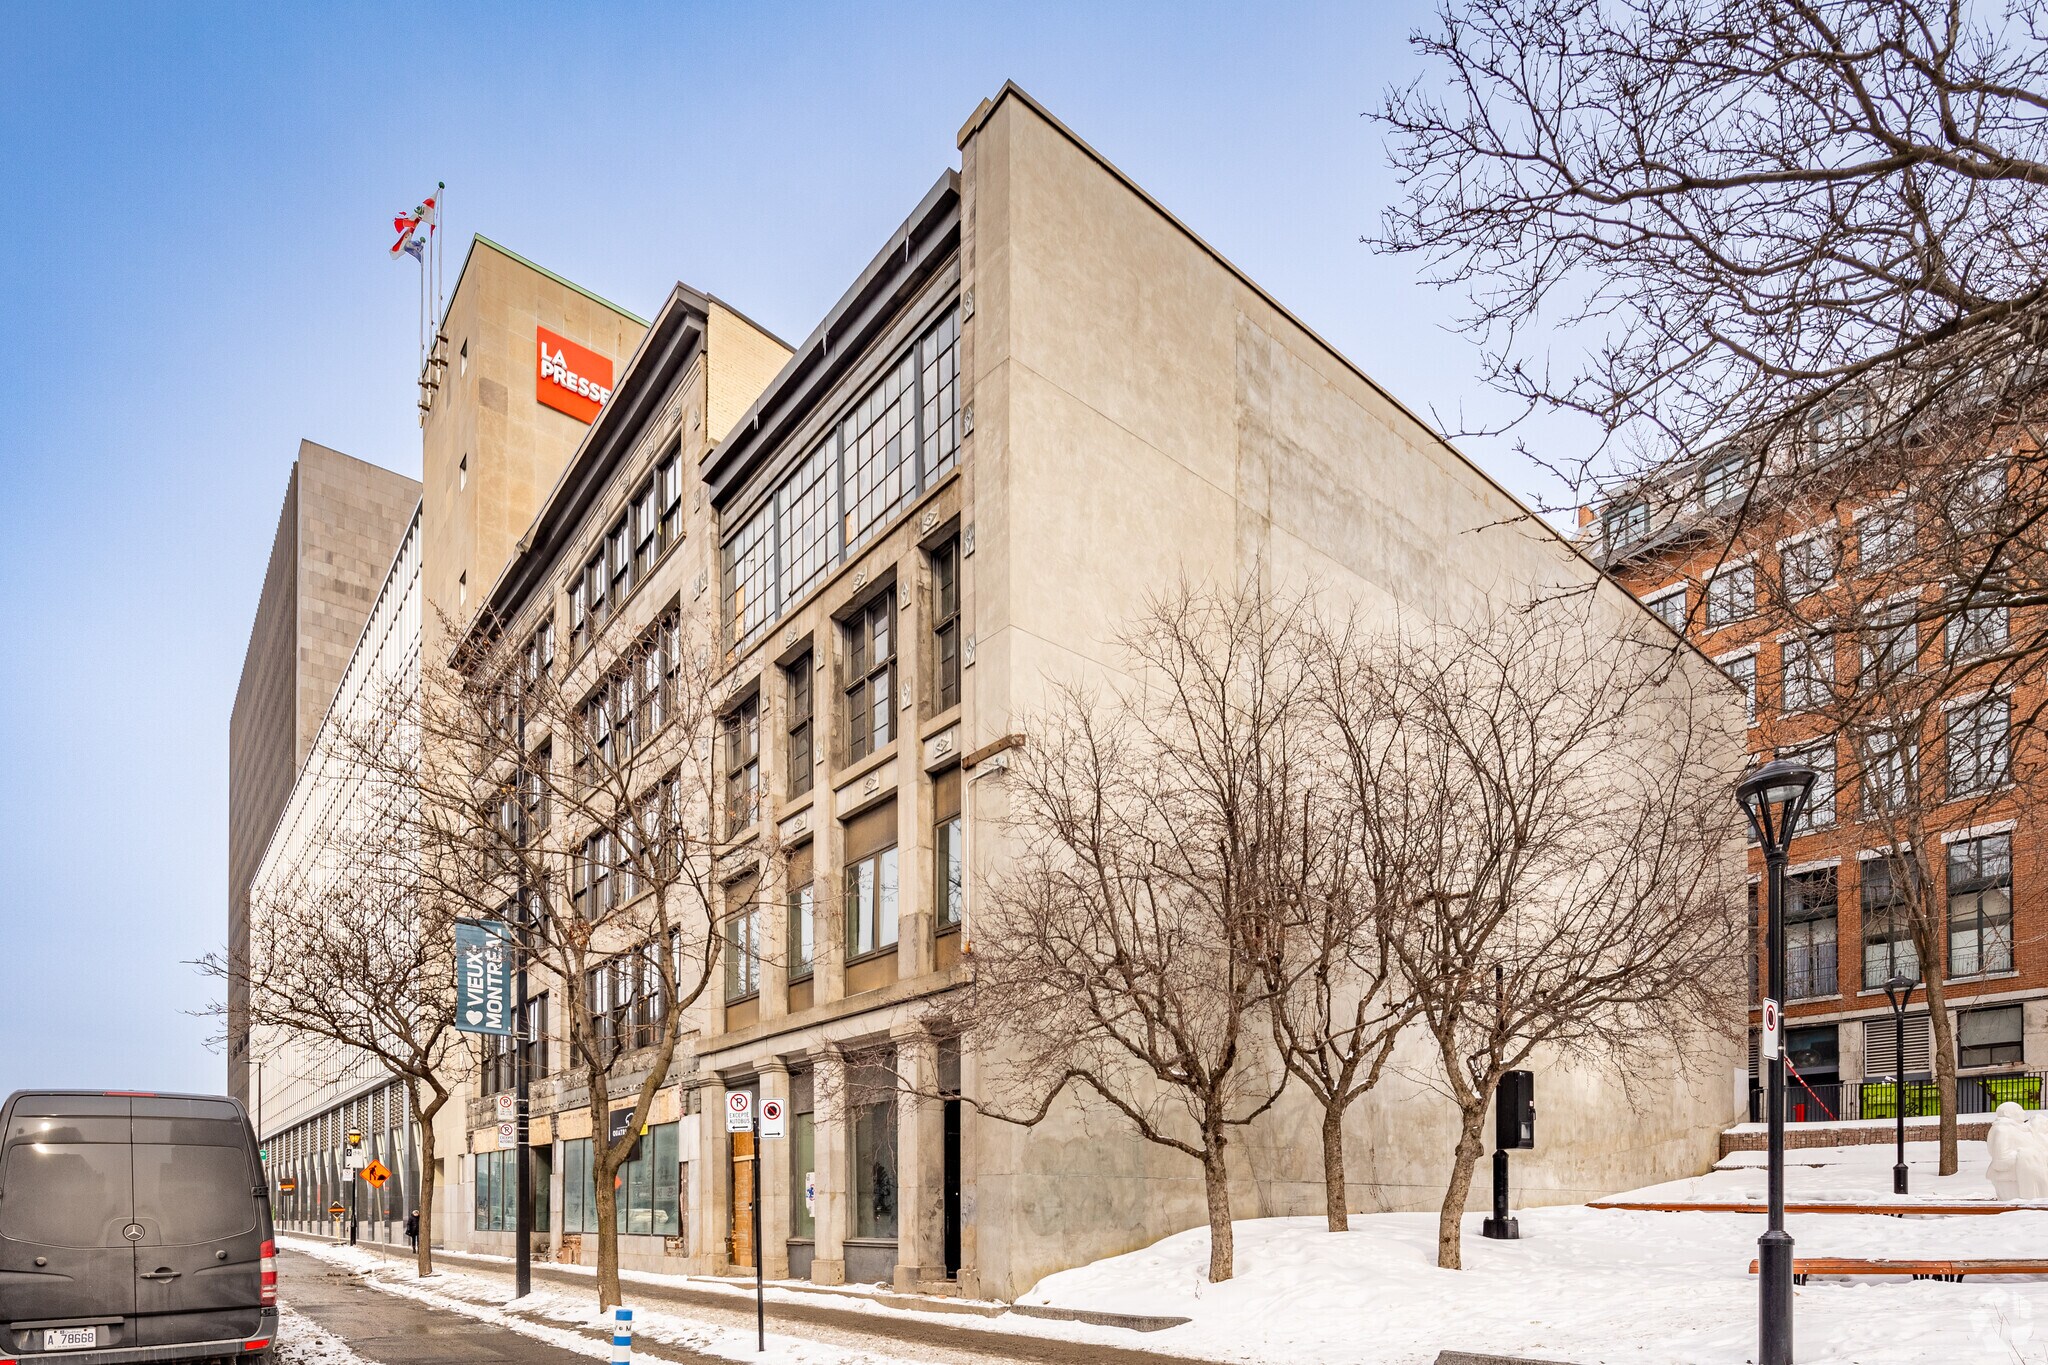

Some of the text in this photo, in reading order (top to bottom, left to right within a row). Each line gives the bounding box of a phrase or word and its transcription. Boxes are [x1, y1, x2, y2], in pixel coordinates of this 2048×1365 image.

[541, 342, 567, 370] LA
[613, 1129, 628, 1137] QUATR
[47, 1333, 94, 1345] A 78668
